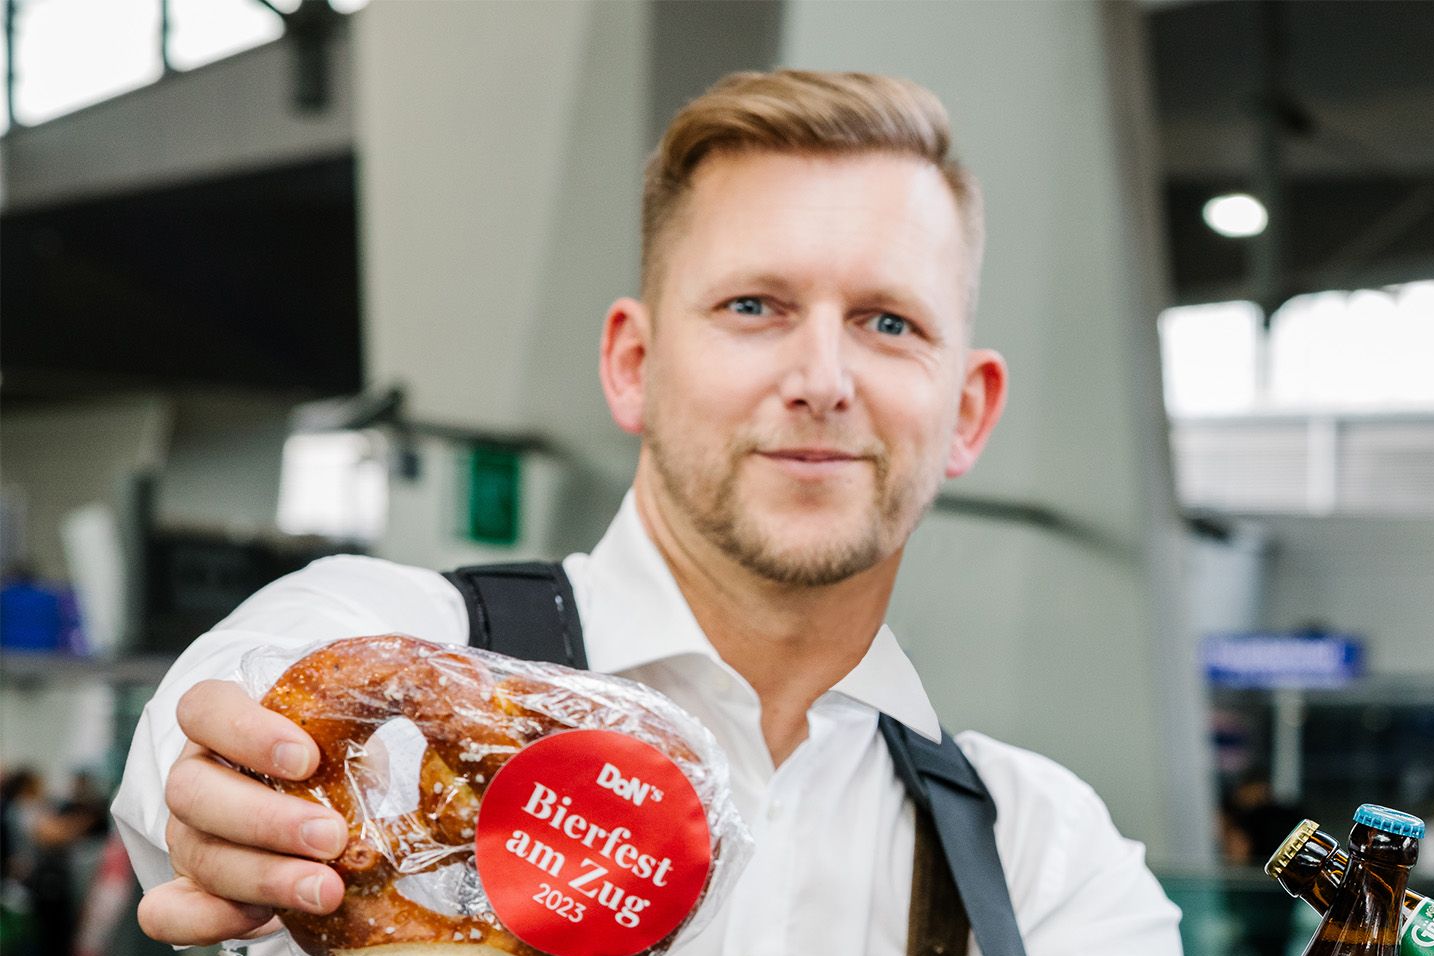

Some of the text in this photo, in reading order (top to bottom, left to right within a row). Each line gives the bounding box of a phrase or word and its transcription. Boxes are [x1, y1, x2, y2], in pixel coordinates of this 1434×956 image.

[505, 829, 650, 928] am Zug
[521, 782, 674, 887] Bierfest
[532, 883, 587, 923] 2023
